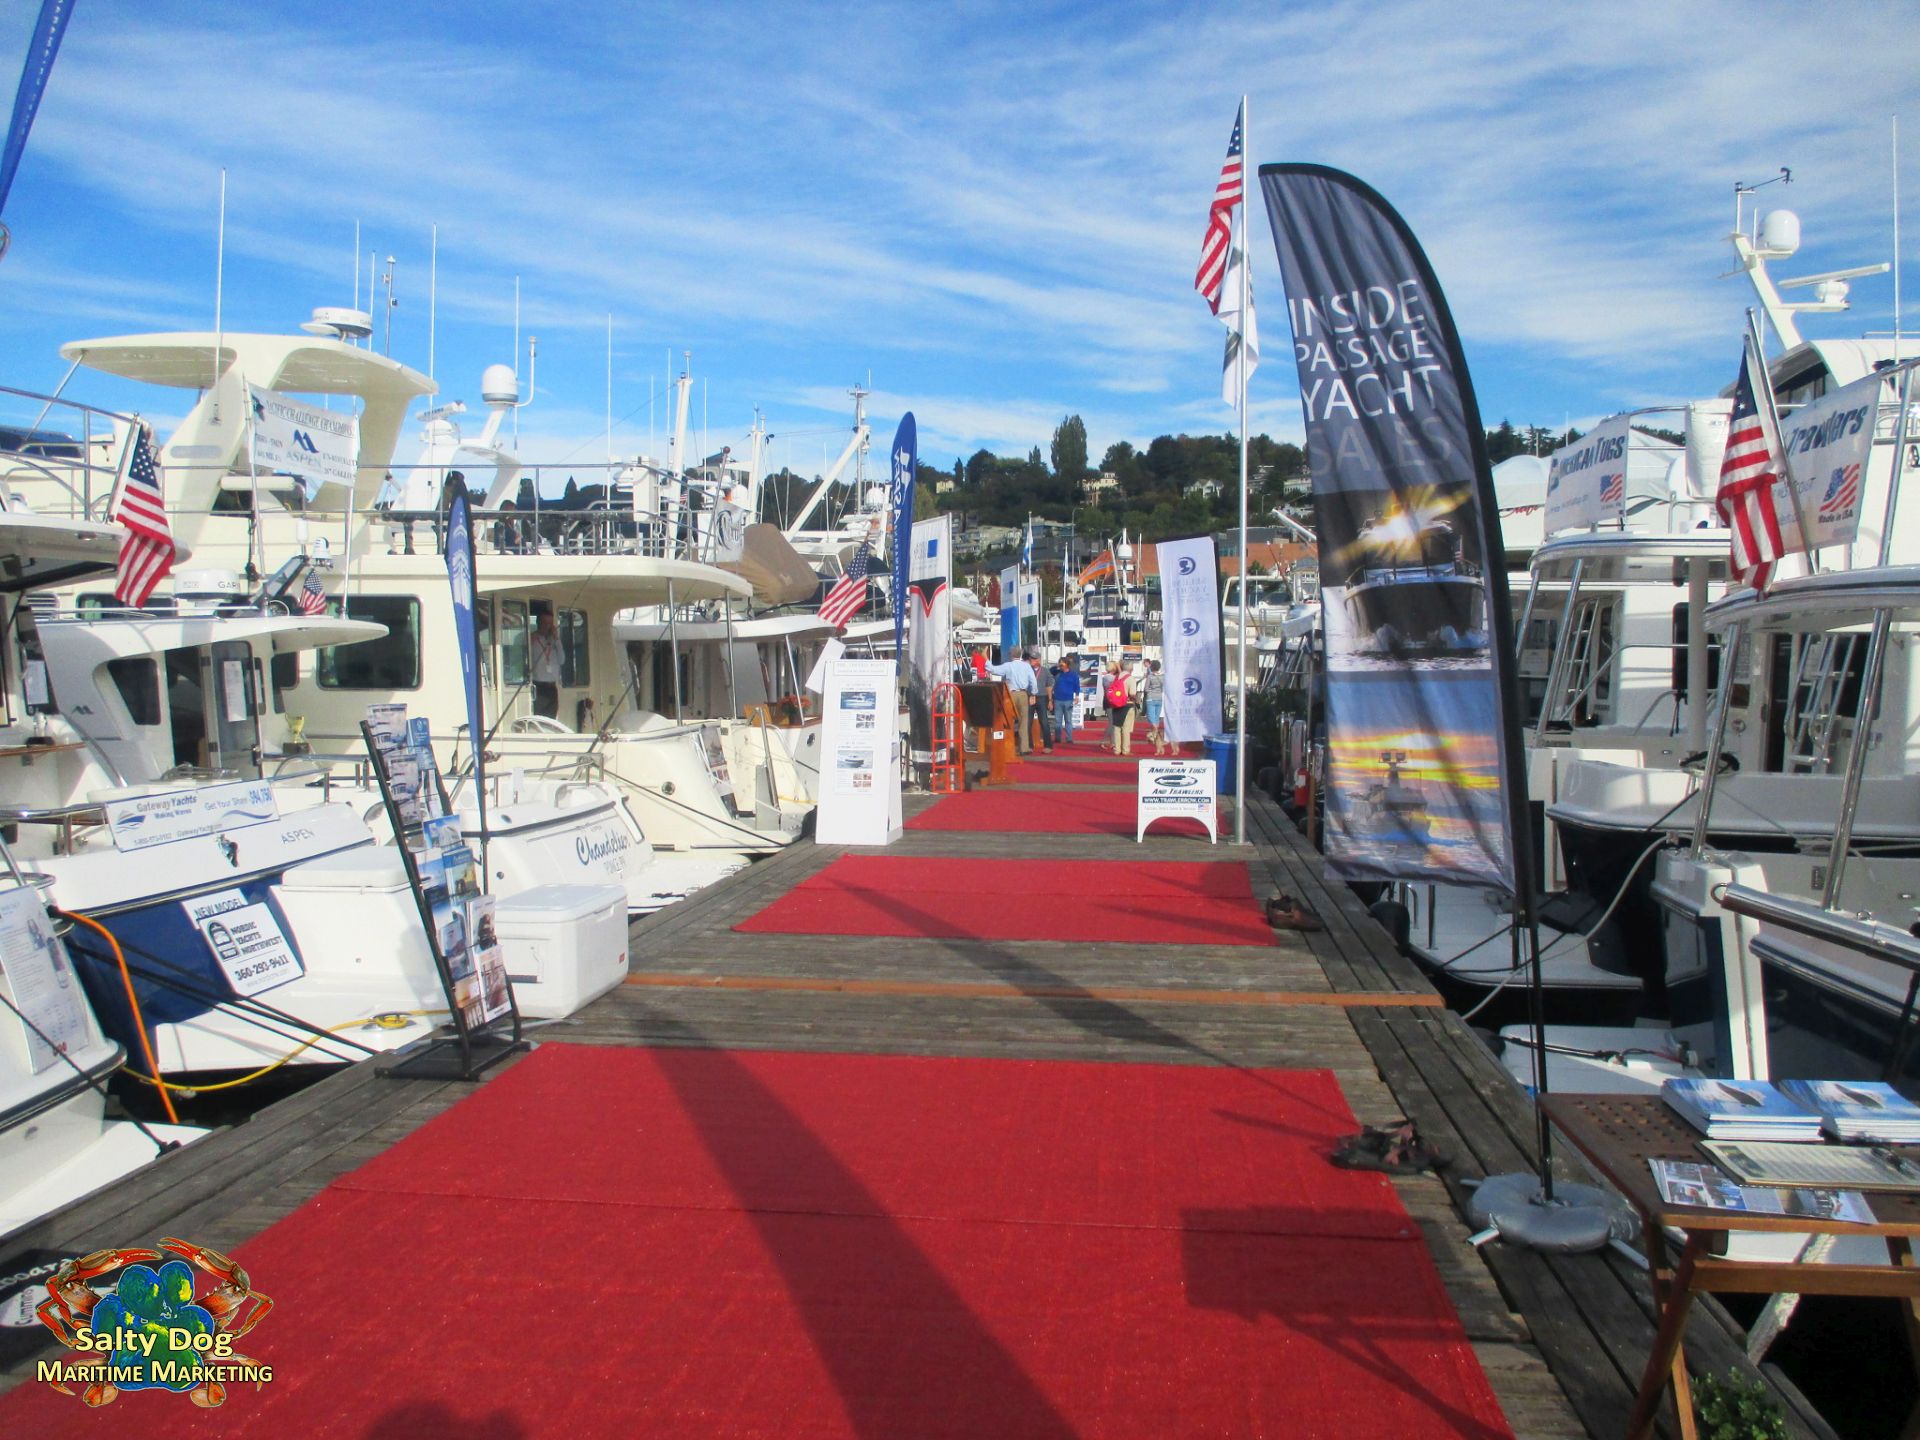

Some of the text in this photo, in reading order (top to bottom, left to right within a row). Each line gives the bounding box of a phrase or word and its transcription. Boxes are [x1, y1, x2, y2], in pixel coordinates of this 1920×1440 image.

[1289, 279, 1424, 337] INSIDE
[1296, 326, 1434, 372] PASSAGE
[1302, 364, 1441, 422] YACHT
[1309, 416, 1453, 476] SAES
[280, 828, 316, 845] ASPEN
[193, 898, 244, 919] NEW MODEL
[230, 921, 258, 936] NORDIC
[234, 953, 290, 981] 360-293-9411
